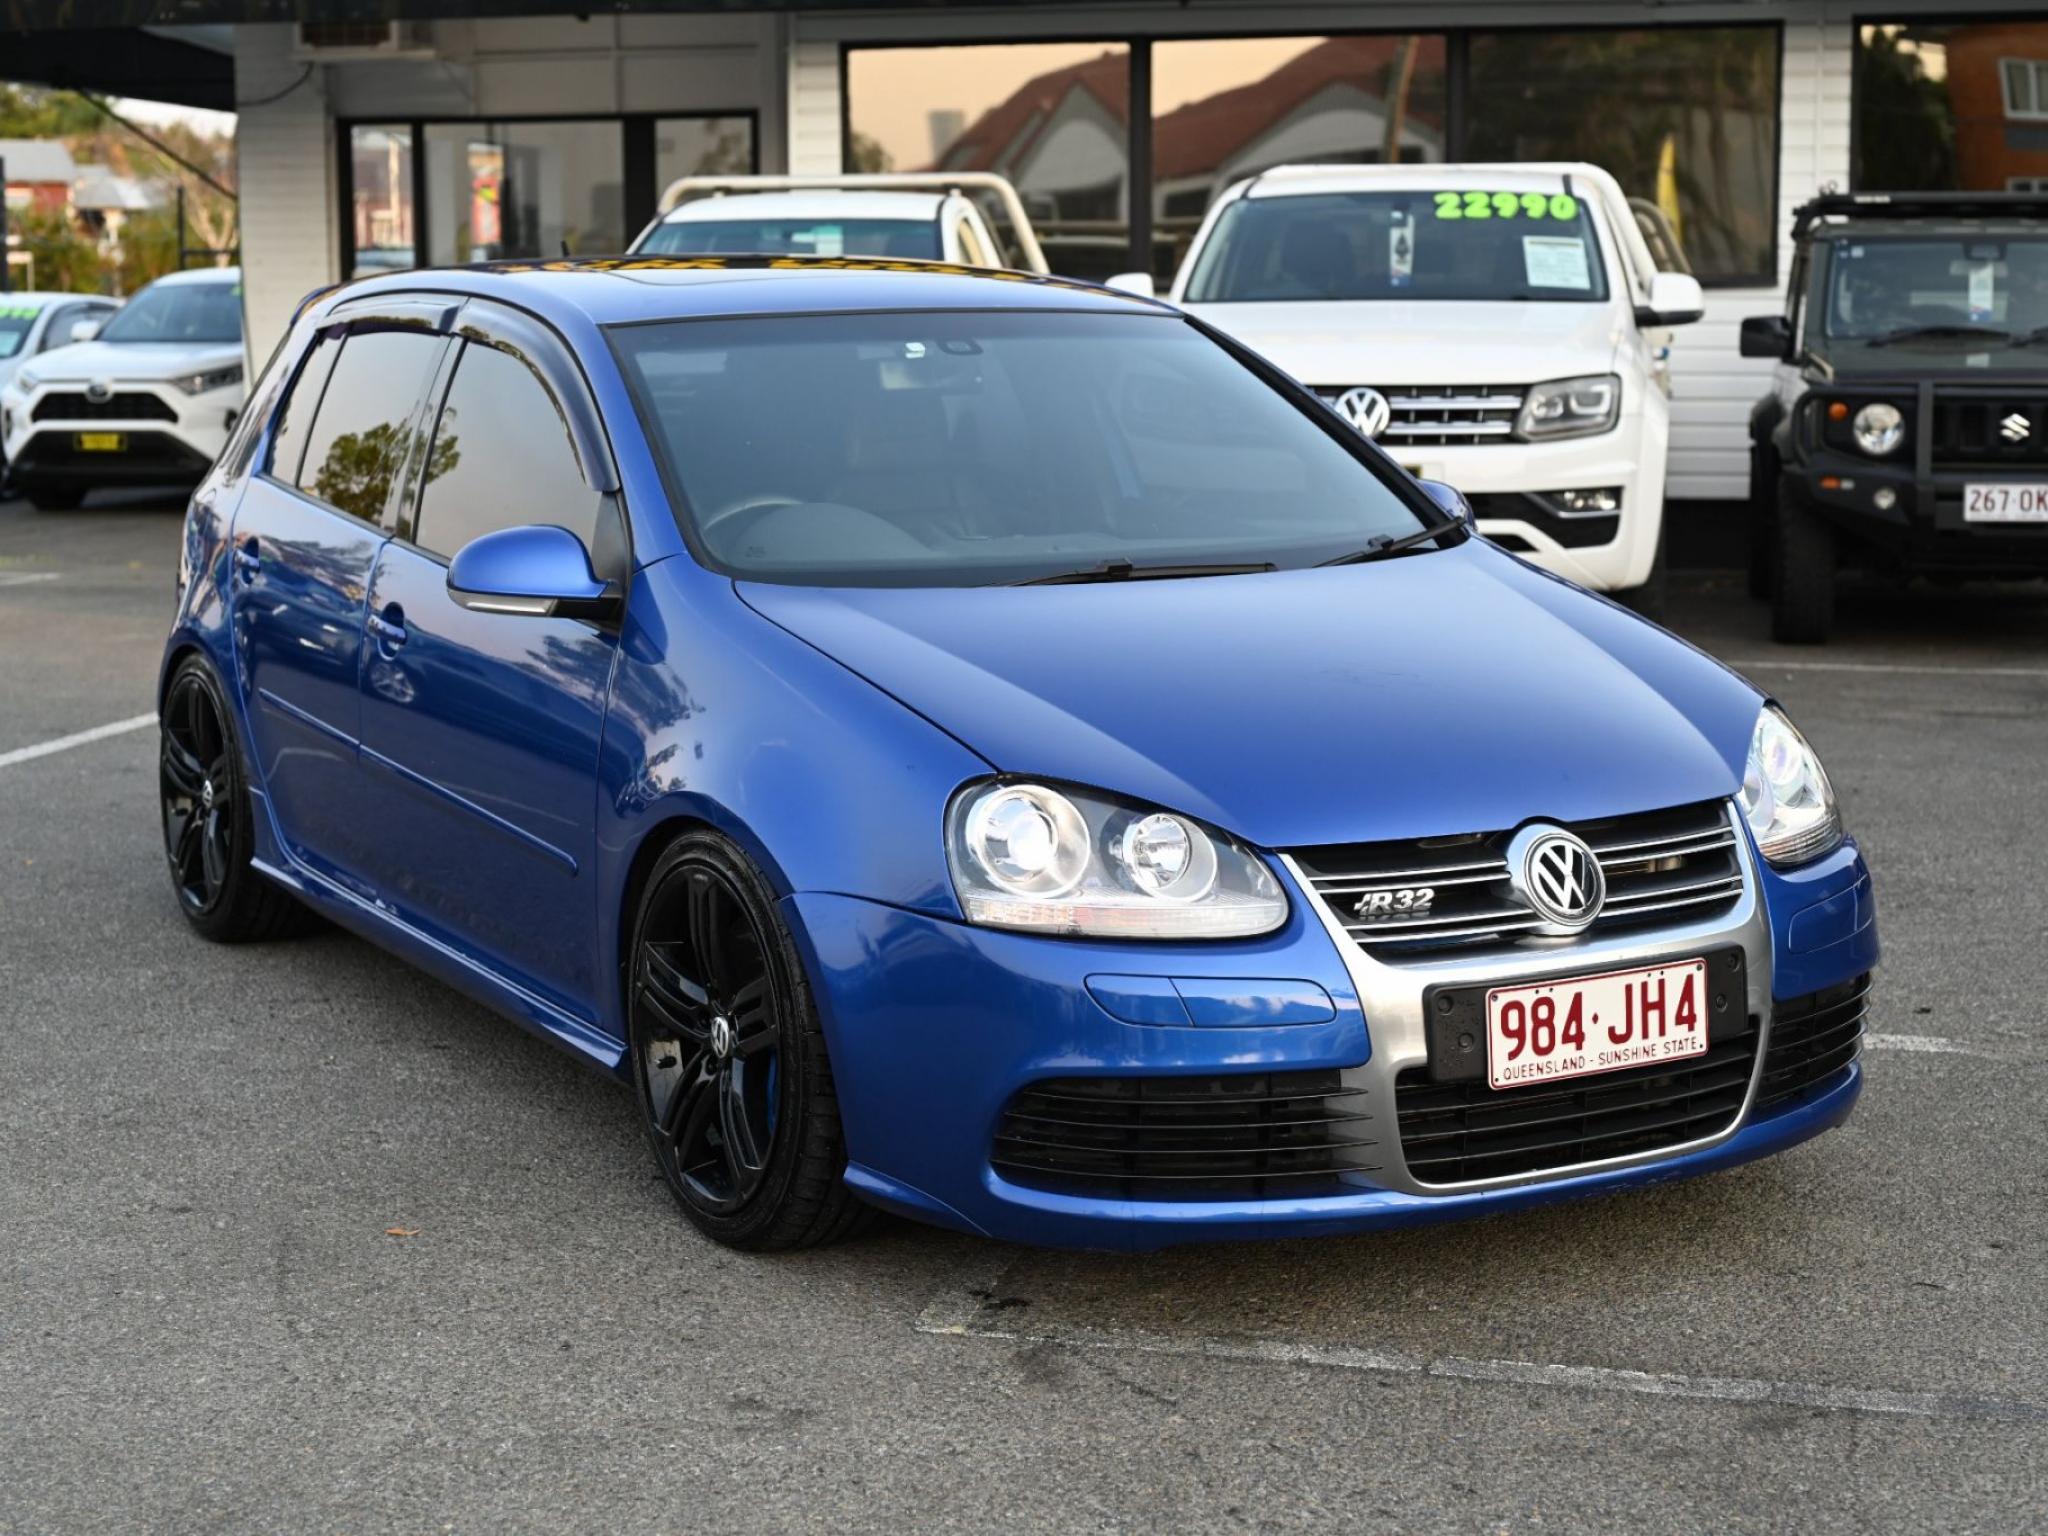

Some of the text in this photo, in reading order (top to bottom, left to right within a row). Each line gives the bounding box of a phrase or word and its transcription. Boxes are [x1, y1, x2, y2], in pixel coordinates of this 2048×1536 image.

[1433, 192, 1578, 221] 22990
[1503, 1055, 1585, 1080] QUEENSLAND
[1599, 1043, 1657, 1066] SUNSHINE
[1663, 1036, 1698, 1055] STATE
